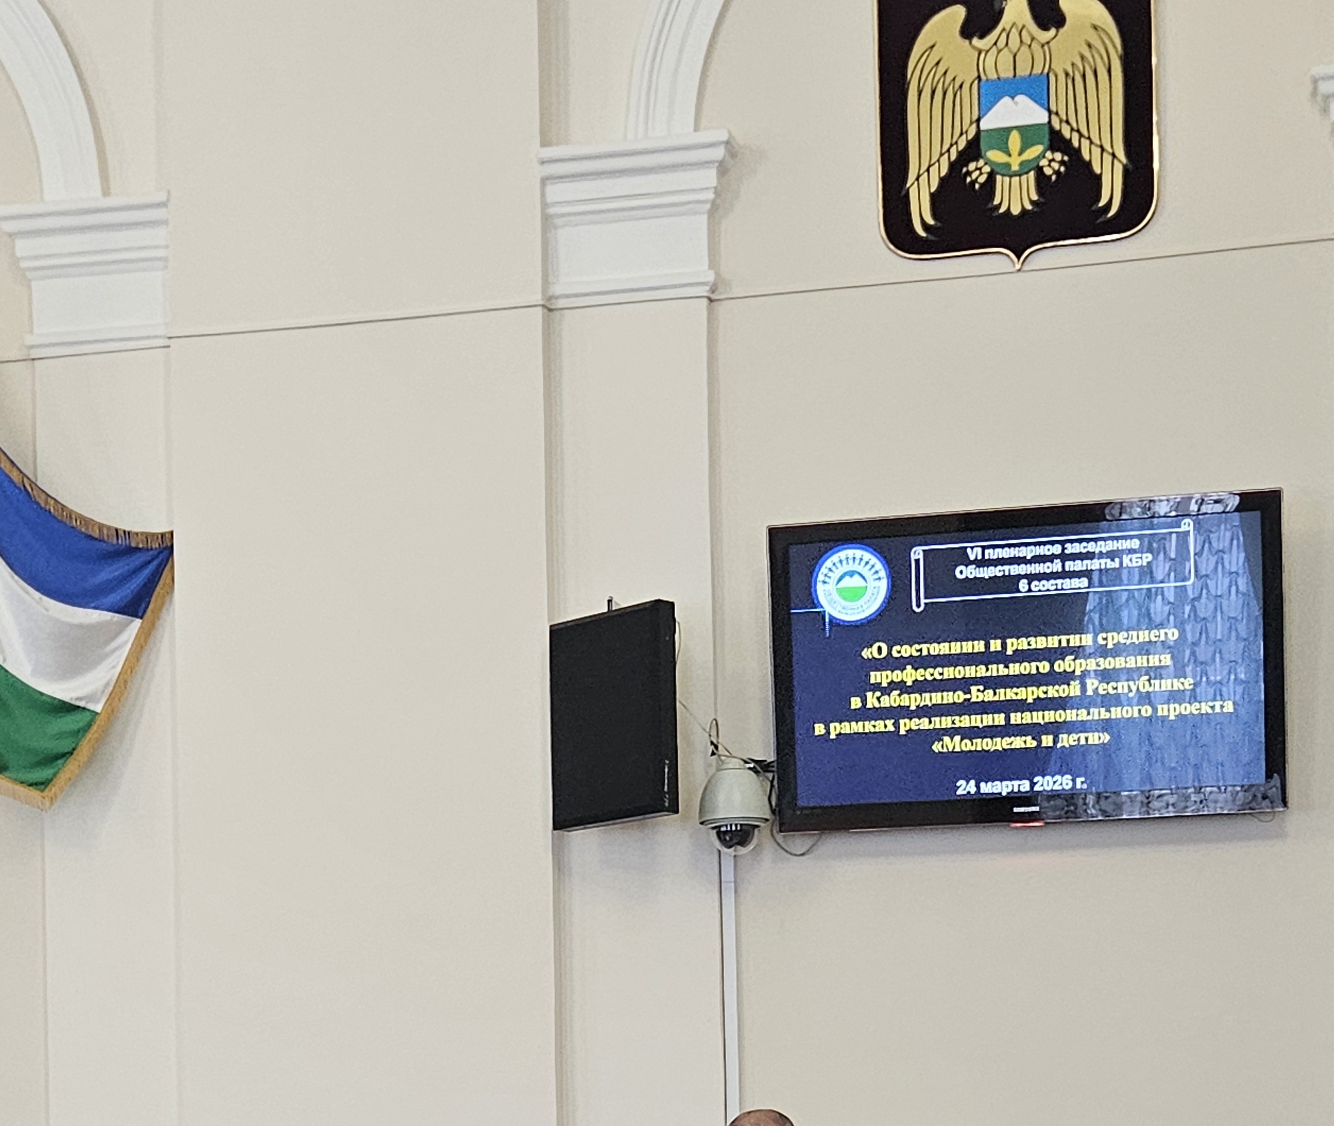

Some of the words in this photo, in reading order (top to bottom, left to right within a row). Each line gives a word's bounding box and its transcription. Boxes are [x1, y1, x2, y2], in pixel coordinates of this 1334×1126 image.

[967, 547, 982, 560] VI
[984, 543, 1062, 561] пленарное
[1065, 538, 1140, 555] заседание
[955, 559, 1062, 580] Общественной
[1065, 556, 1119, 571] палаты
[1122, 553, 1153, 567] КБР
[1019, 579, 1029, 592] 6
[1031, 576, 1088, 591] состава
[861, 642, 888, 659] «О
[891, 639, 985, 657] состоянии
[989, 639, 1002, 651] и
[1006, 633, 1093, 655] развитии
[1097, 628, 1180, 648] среднего
[869, 658, 1050, 686] профессионального
[1054, 653, 1172, 675] образования
[850, 696, 862, 709] в
[866, 680, 1081, 710] Кабардино-Балкарской
[1086, 675, 1194, 697] Республике
[814, 722, 826, 735] в
[829, 718, 896, 739] рамках
[899, 712, 1006, 735] реализации
[1010, 705, 1153, 725] национального
[1157, 700, 1234, 719] проекта
[931, 734, 1038, 753] «Молодежь
[1041, 734, 1054, 747] и
[1057, 731, 1111, 748] дети»
[956, 779, 976, 795] 24
[980, 779, 1031, 796] марта
[1033, 775, 1073, 791] 2026
[1076, 776, 1087, 789] г.
